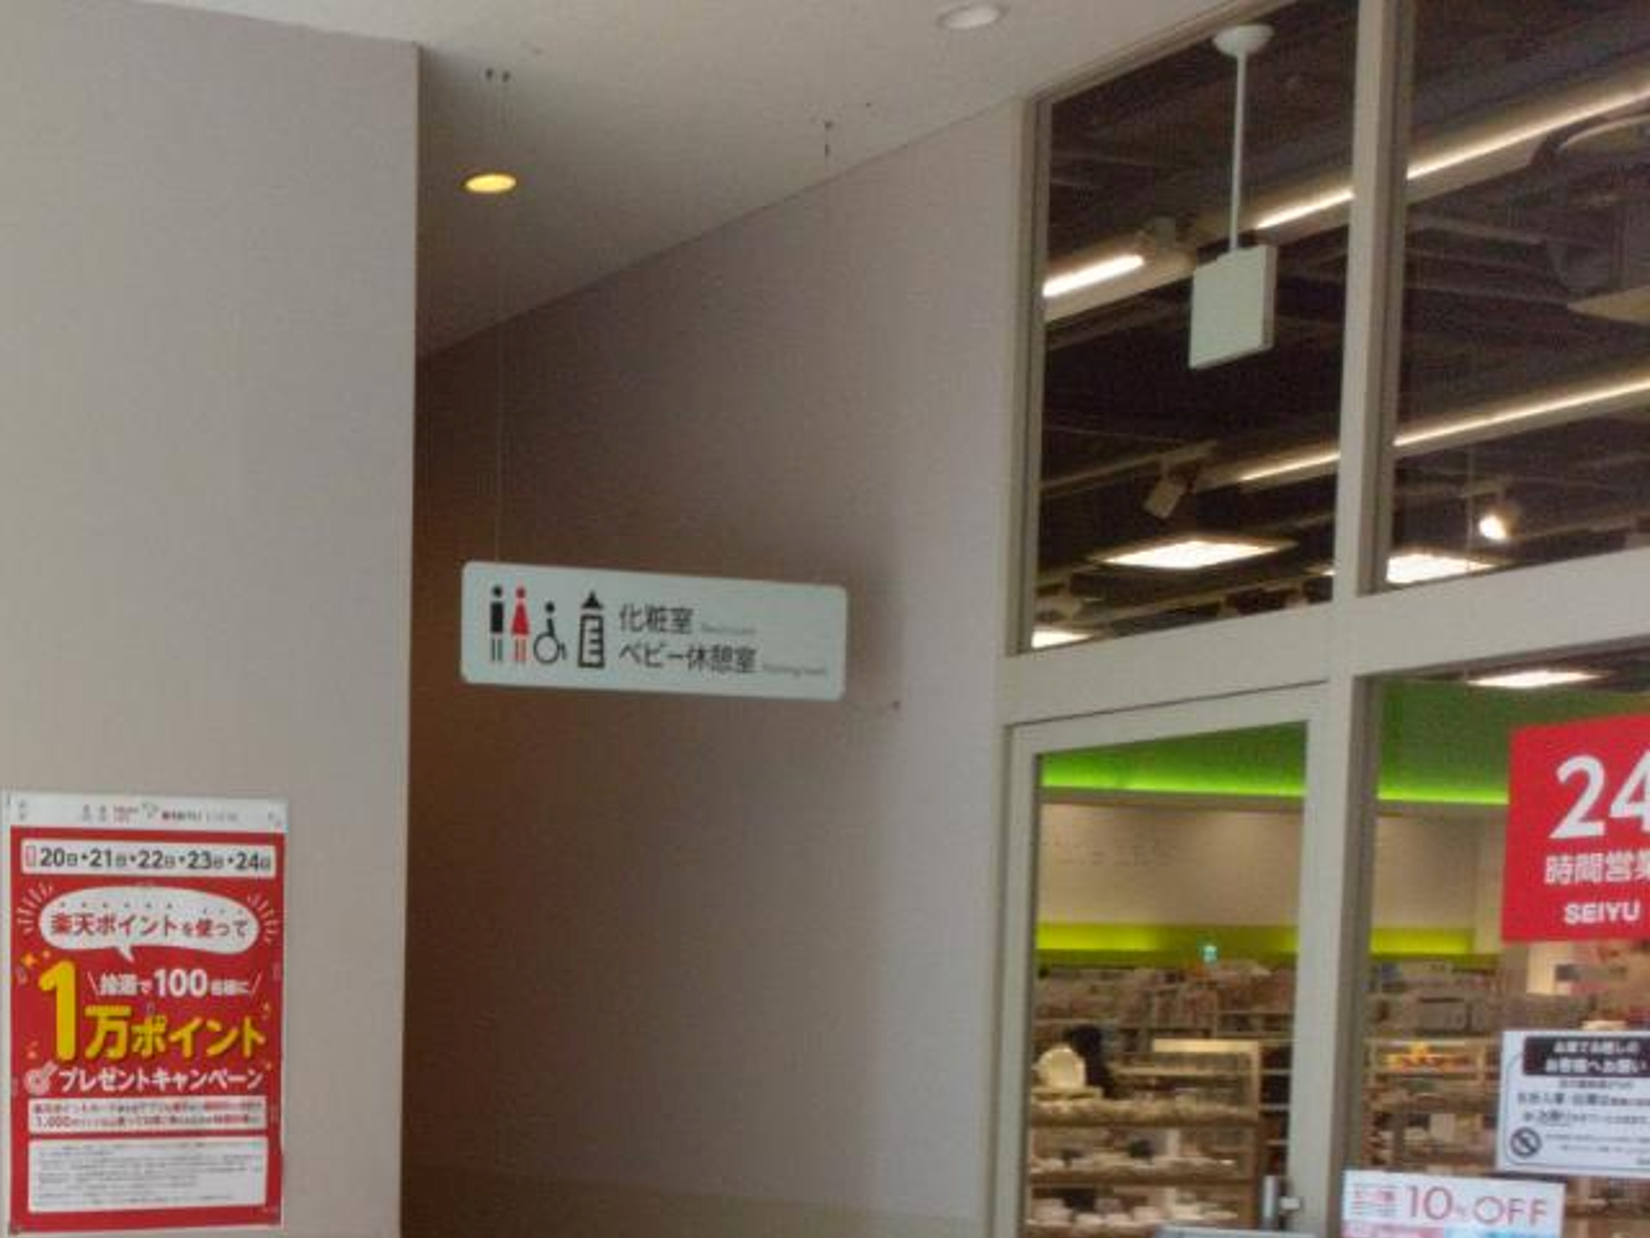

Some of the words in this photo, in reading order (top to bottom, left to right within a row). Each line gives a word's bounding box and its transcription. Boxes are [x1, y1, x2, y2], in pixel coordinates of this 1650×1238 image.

[618, 604, 694, 635] 化粧室
[618, 641, 758, 674] ベビー休憩室
[50, 912, 250, 938] 楽天ポイントを使って
[1564, 901, 1641, 924] SEIYU
[38, 960, 266, 1061] 1万ポイント
[58, 1066, 264, 1092] プレゼントキャンペーン
